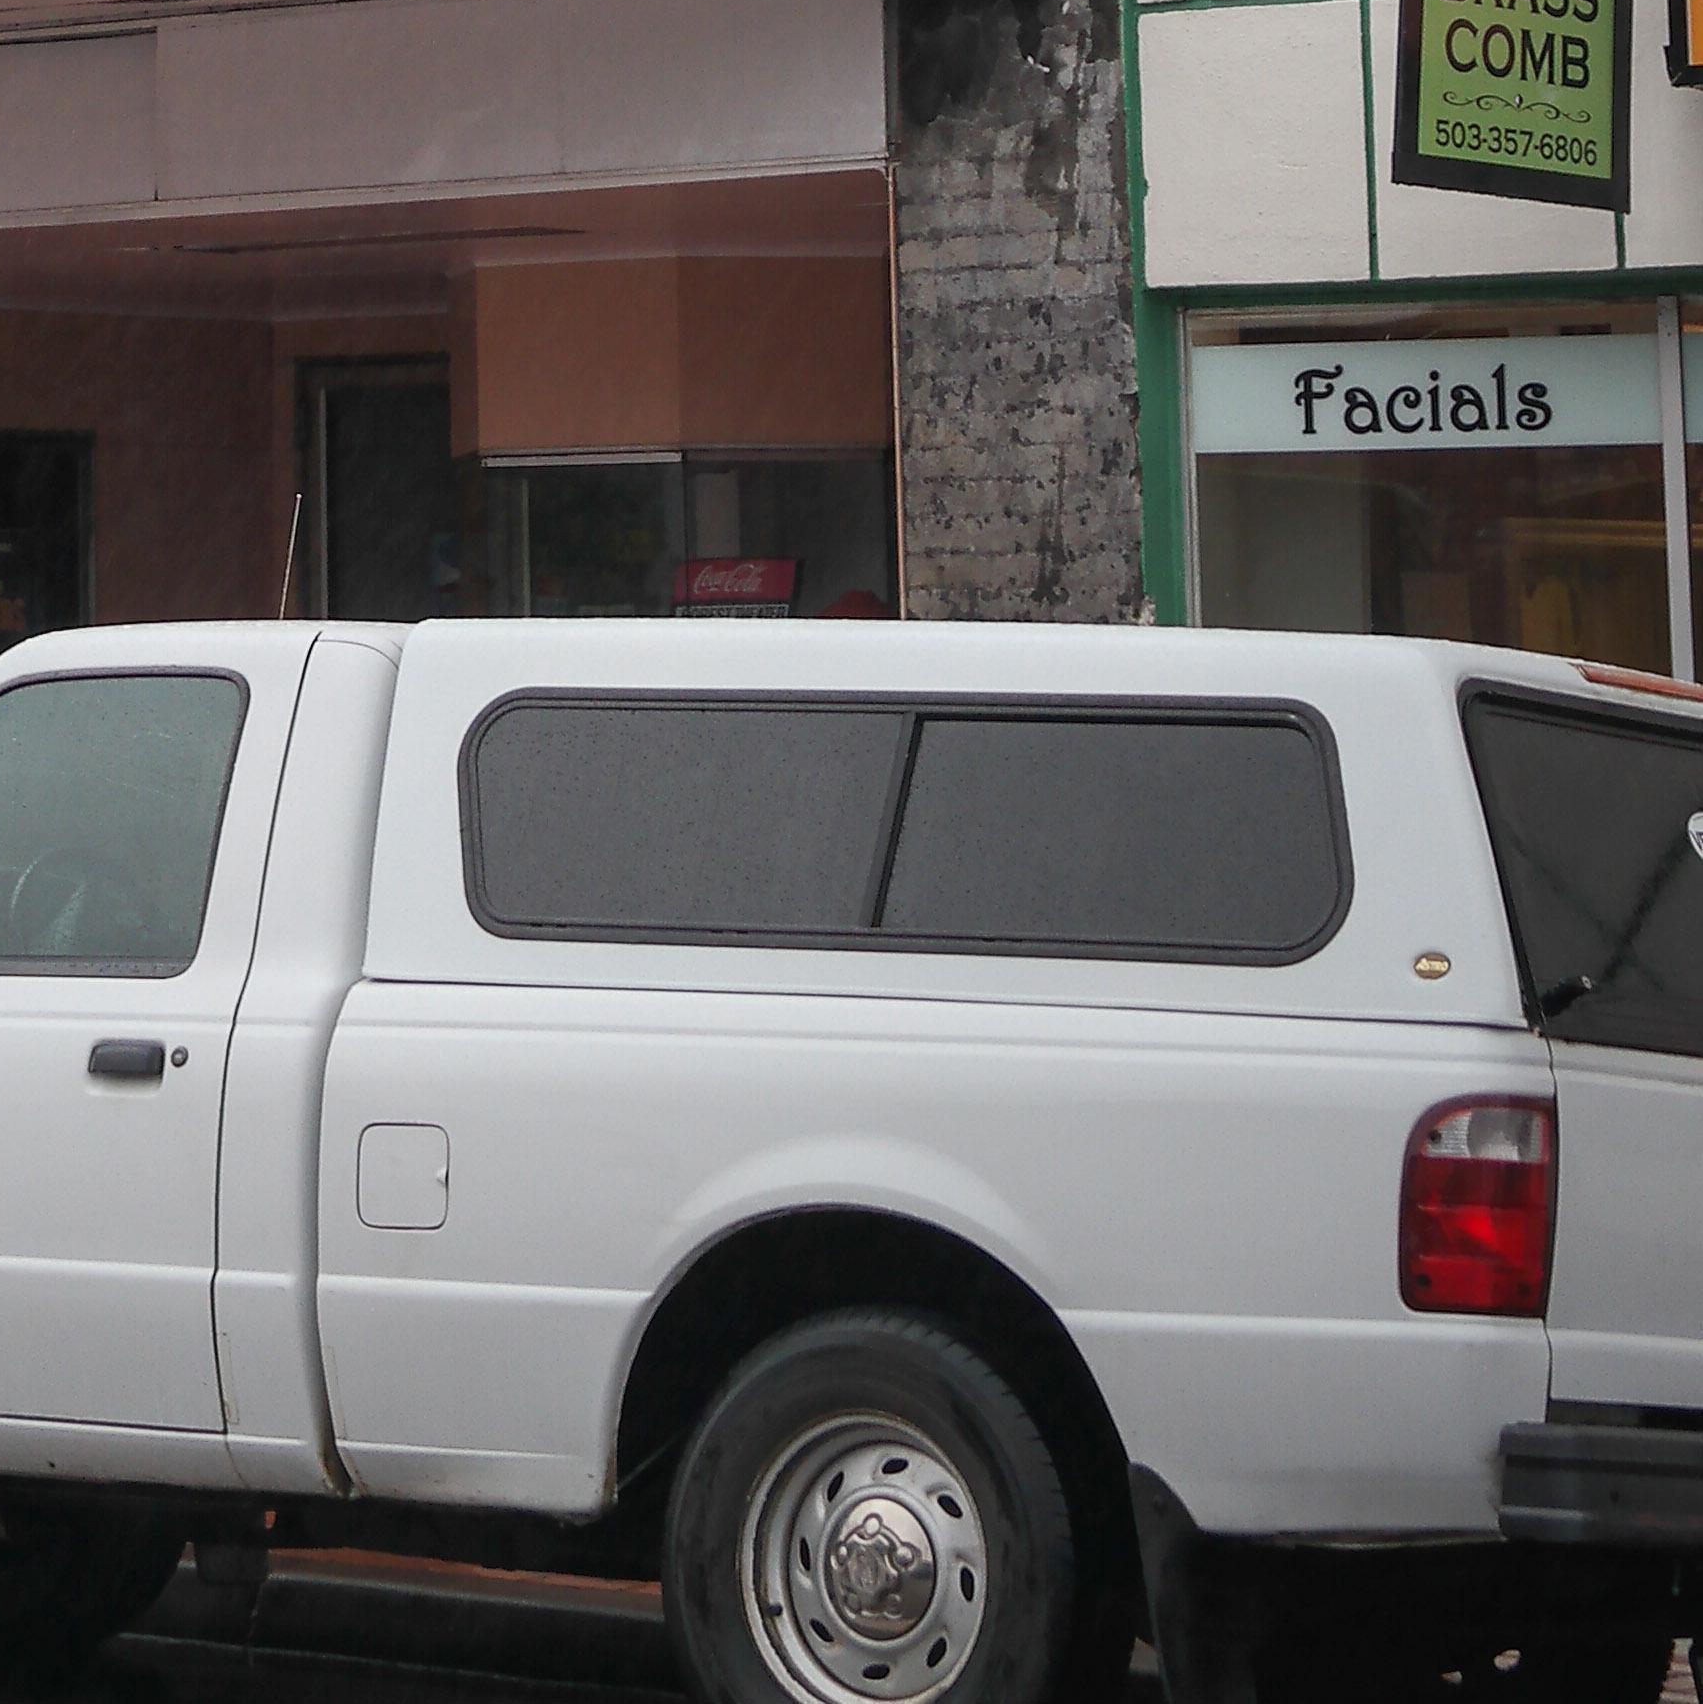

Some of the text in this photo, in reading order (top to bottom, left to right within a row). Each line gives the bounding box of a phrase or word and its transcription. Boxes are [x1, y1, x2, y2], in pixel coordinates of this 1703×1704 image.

[1444, 18, 1591, 90] COMB
[1435, 118, 1598, 166] 503-357-6806
[1294, 363, 1554, 435] Facials
